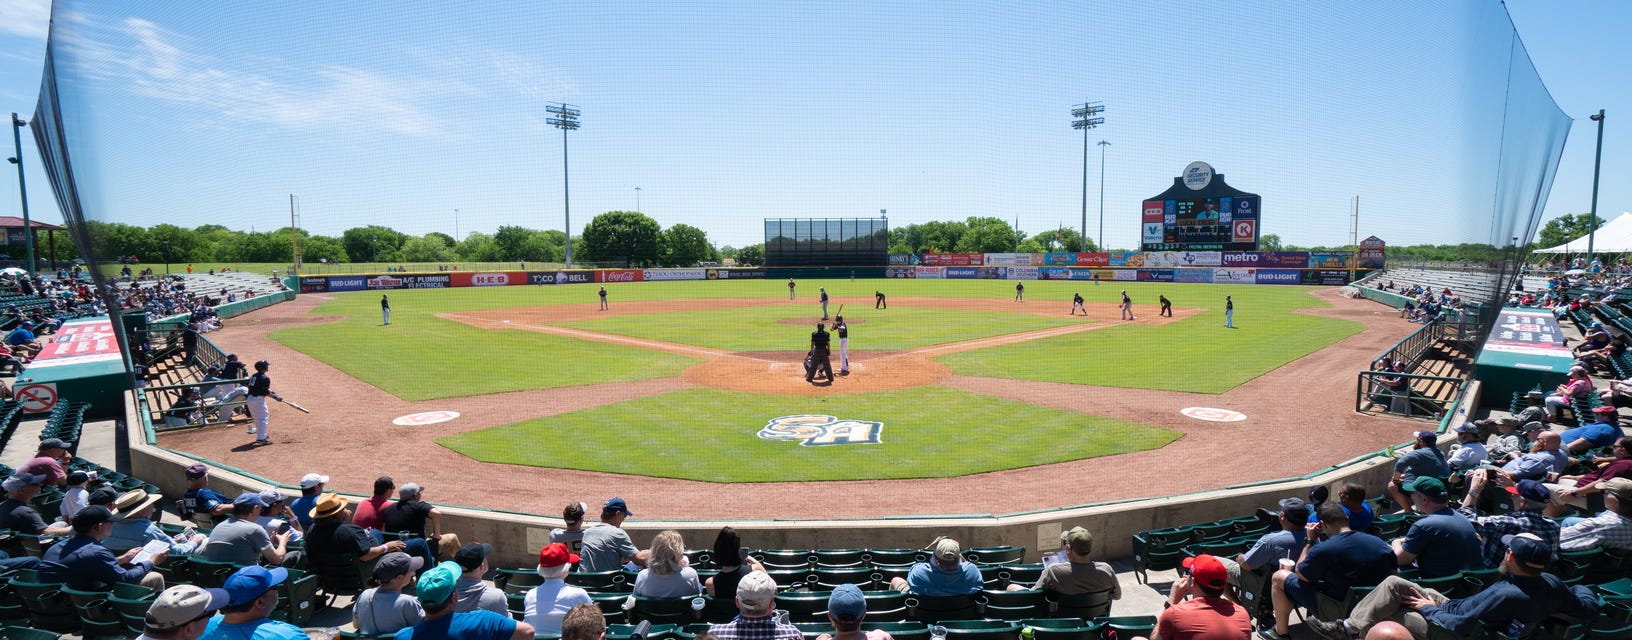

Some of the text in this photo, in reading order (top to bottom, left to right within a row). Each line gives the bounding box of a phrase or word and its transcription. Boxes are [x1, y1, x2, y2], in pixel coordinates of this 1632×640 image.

[1224, 252, 1258, 262] metro
[569, 274, 588, 282] BELL
[608, 271, 635, 281] Coca-Cola
